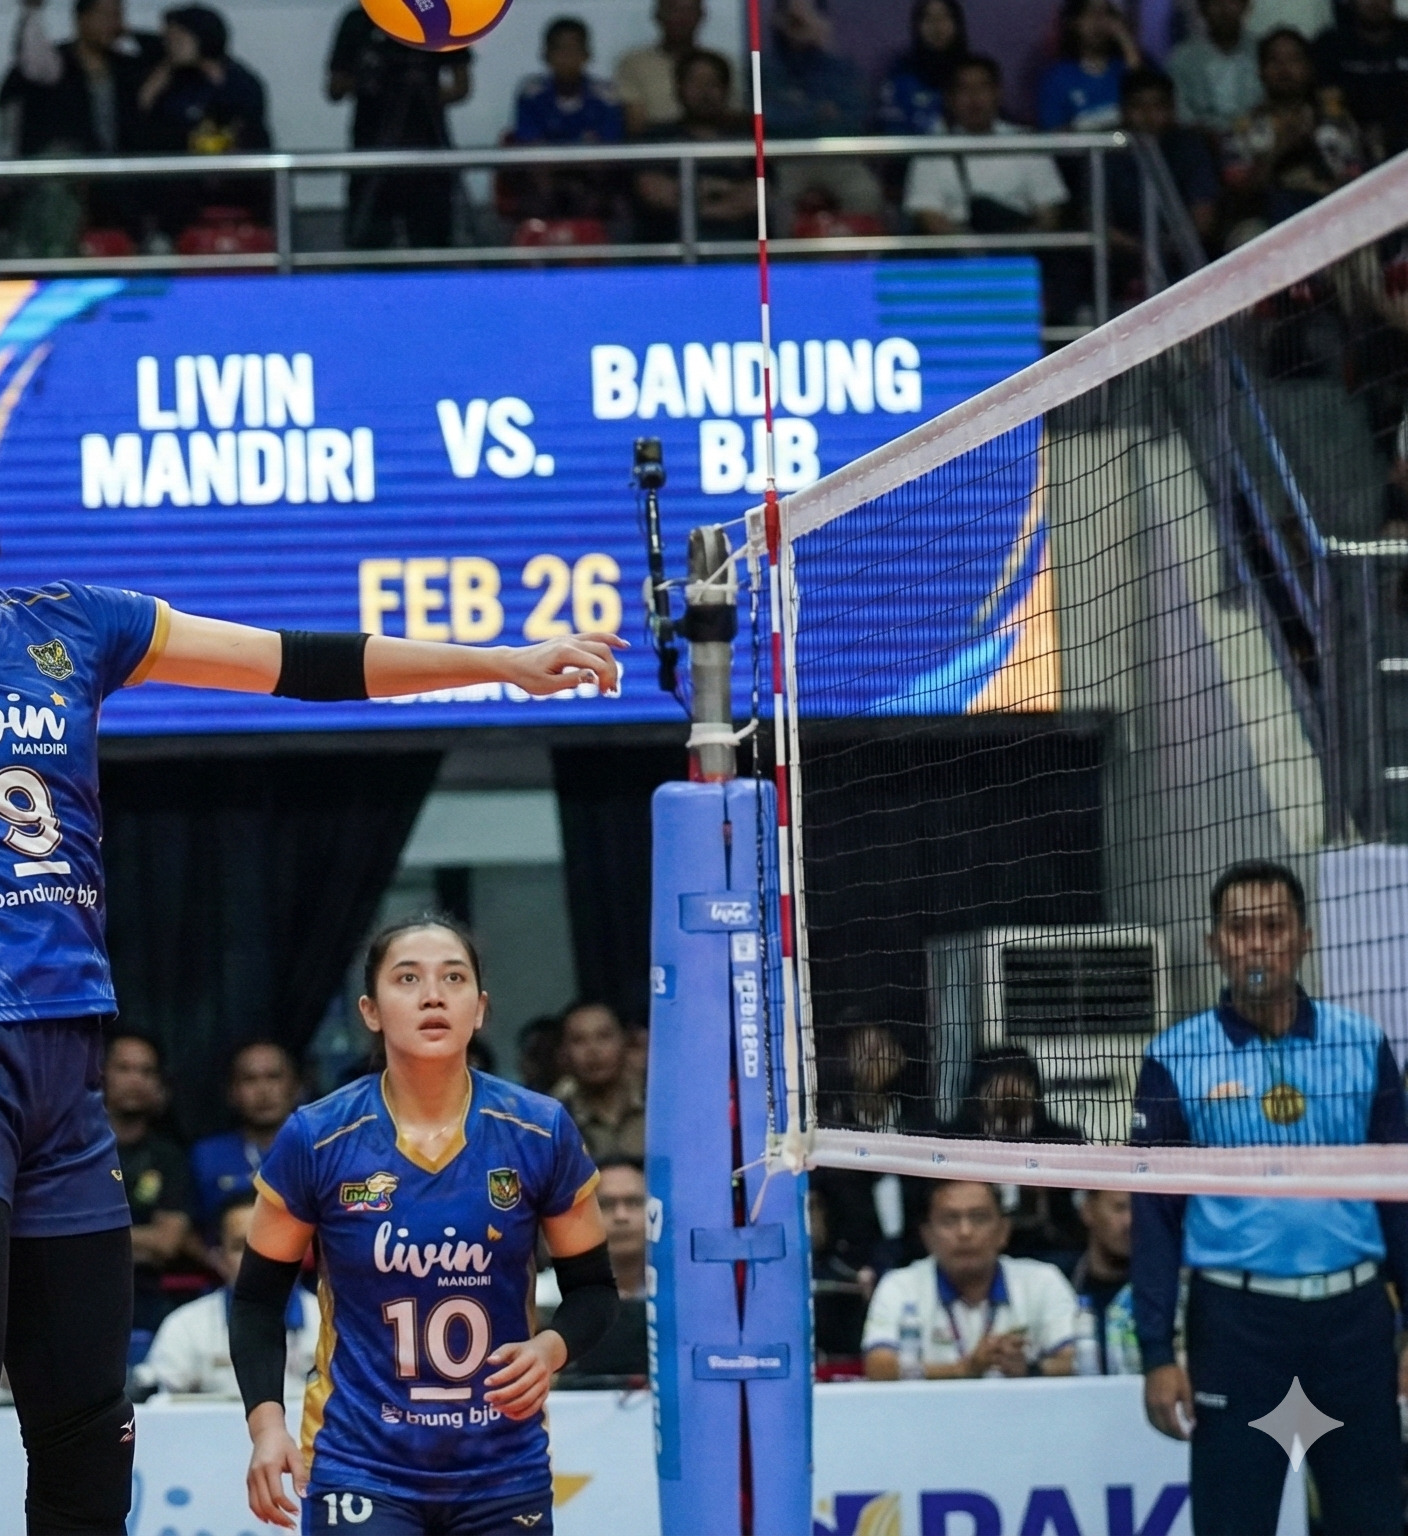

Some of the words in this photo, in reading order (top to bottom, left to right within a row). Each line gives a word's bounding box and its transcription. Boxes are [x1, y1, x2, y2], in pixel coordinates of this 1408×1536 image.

[137, 353, 315, 430] LIVIN
[591, 337, 922, 420] BANDUNG
[80, 427, 375, 509] MANDIRI
[436, 397, 555, 479] VS.
[699, 417, 820, 494] BJB
[358, 556, 504, 643] FEB
[521, 553, 623, 642] 26
[11, 743, 68, 755] MANDIRI
[374, 1220, 492, 1278] livin
[438, 1275, 491, 1286] MANDIRI
[382, 1294, 493, 1381] 10
[322, 1493, 373, 1526] 10
